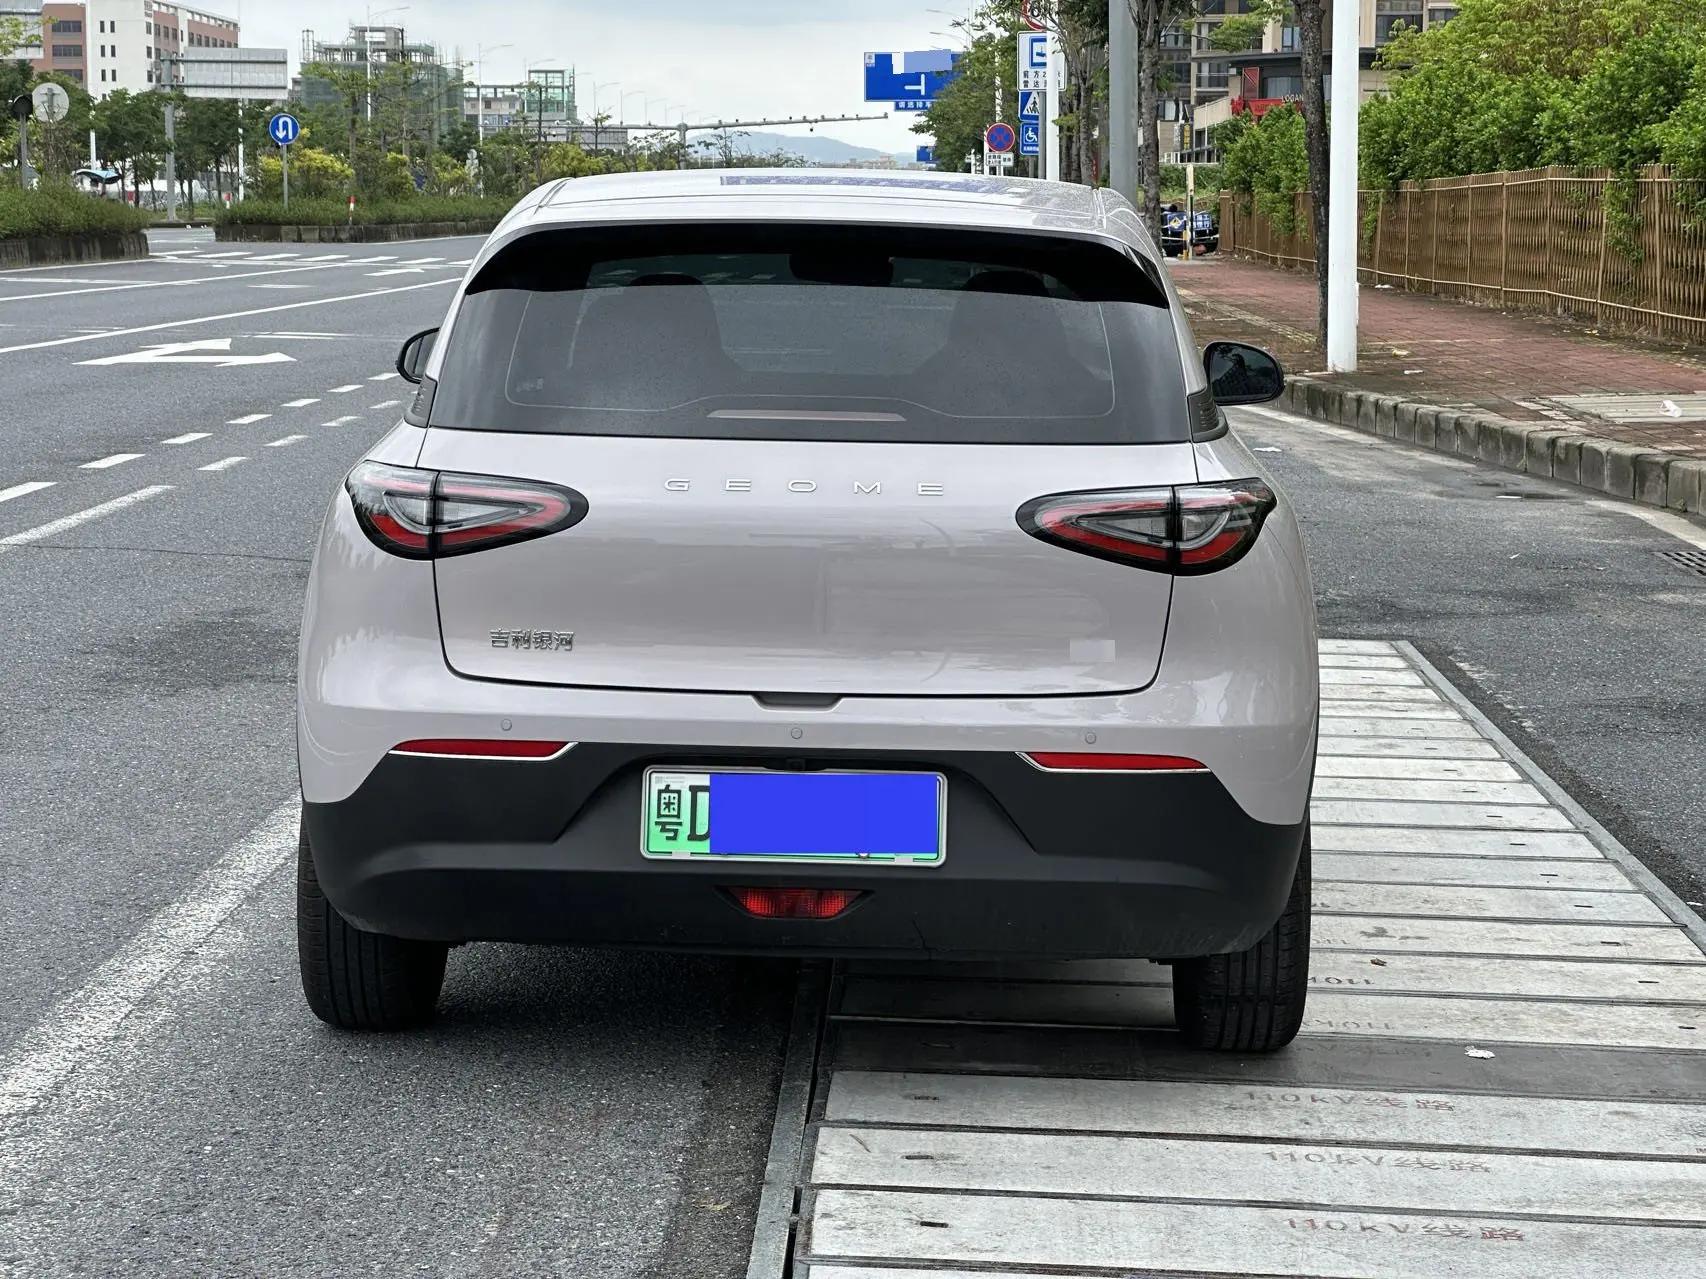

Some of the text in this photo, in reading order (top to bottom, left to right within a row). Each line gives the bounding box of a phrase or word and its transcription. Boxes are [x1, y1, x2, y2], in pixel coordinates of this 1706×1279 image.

[664, 478, 945, 497] GEOME
[490, 627, 575, 652] 吉利银河
